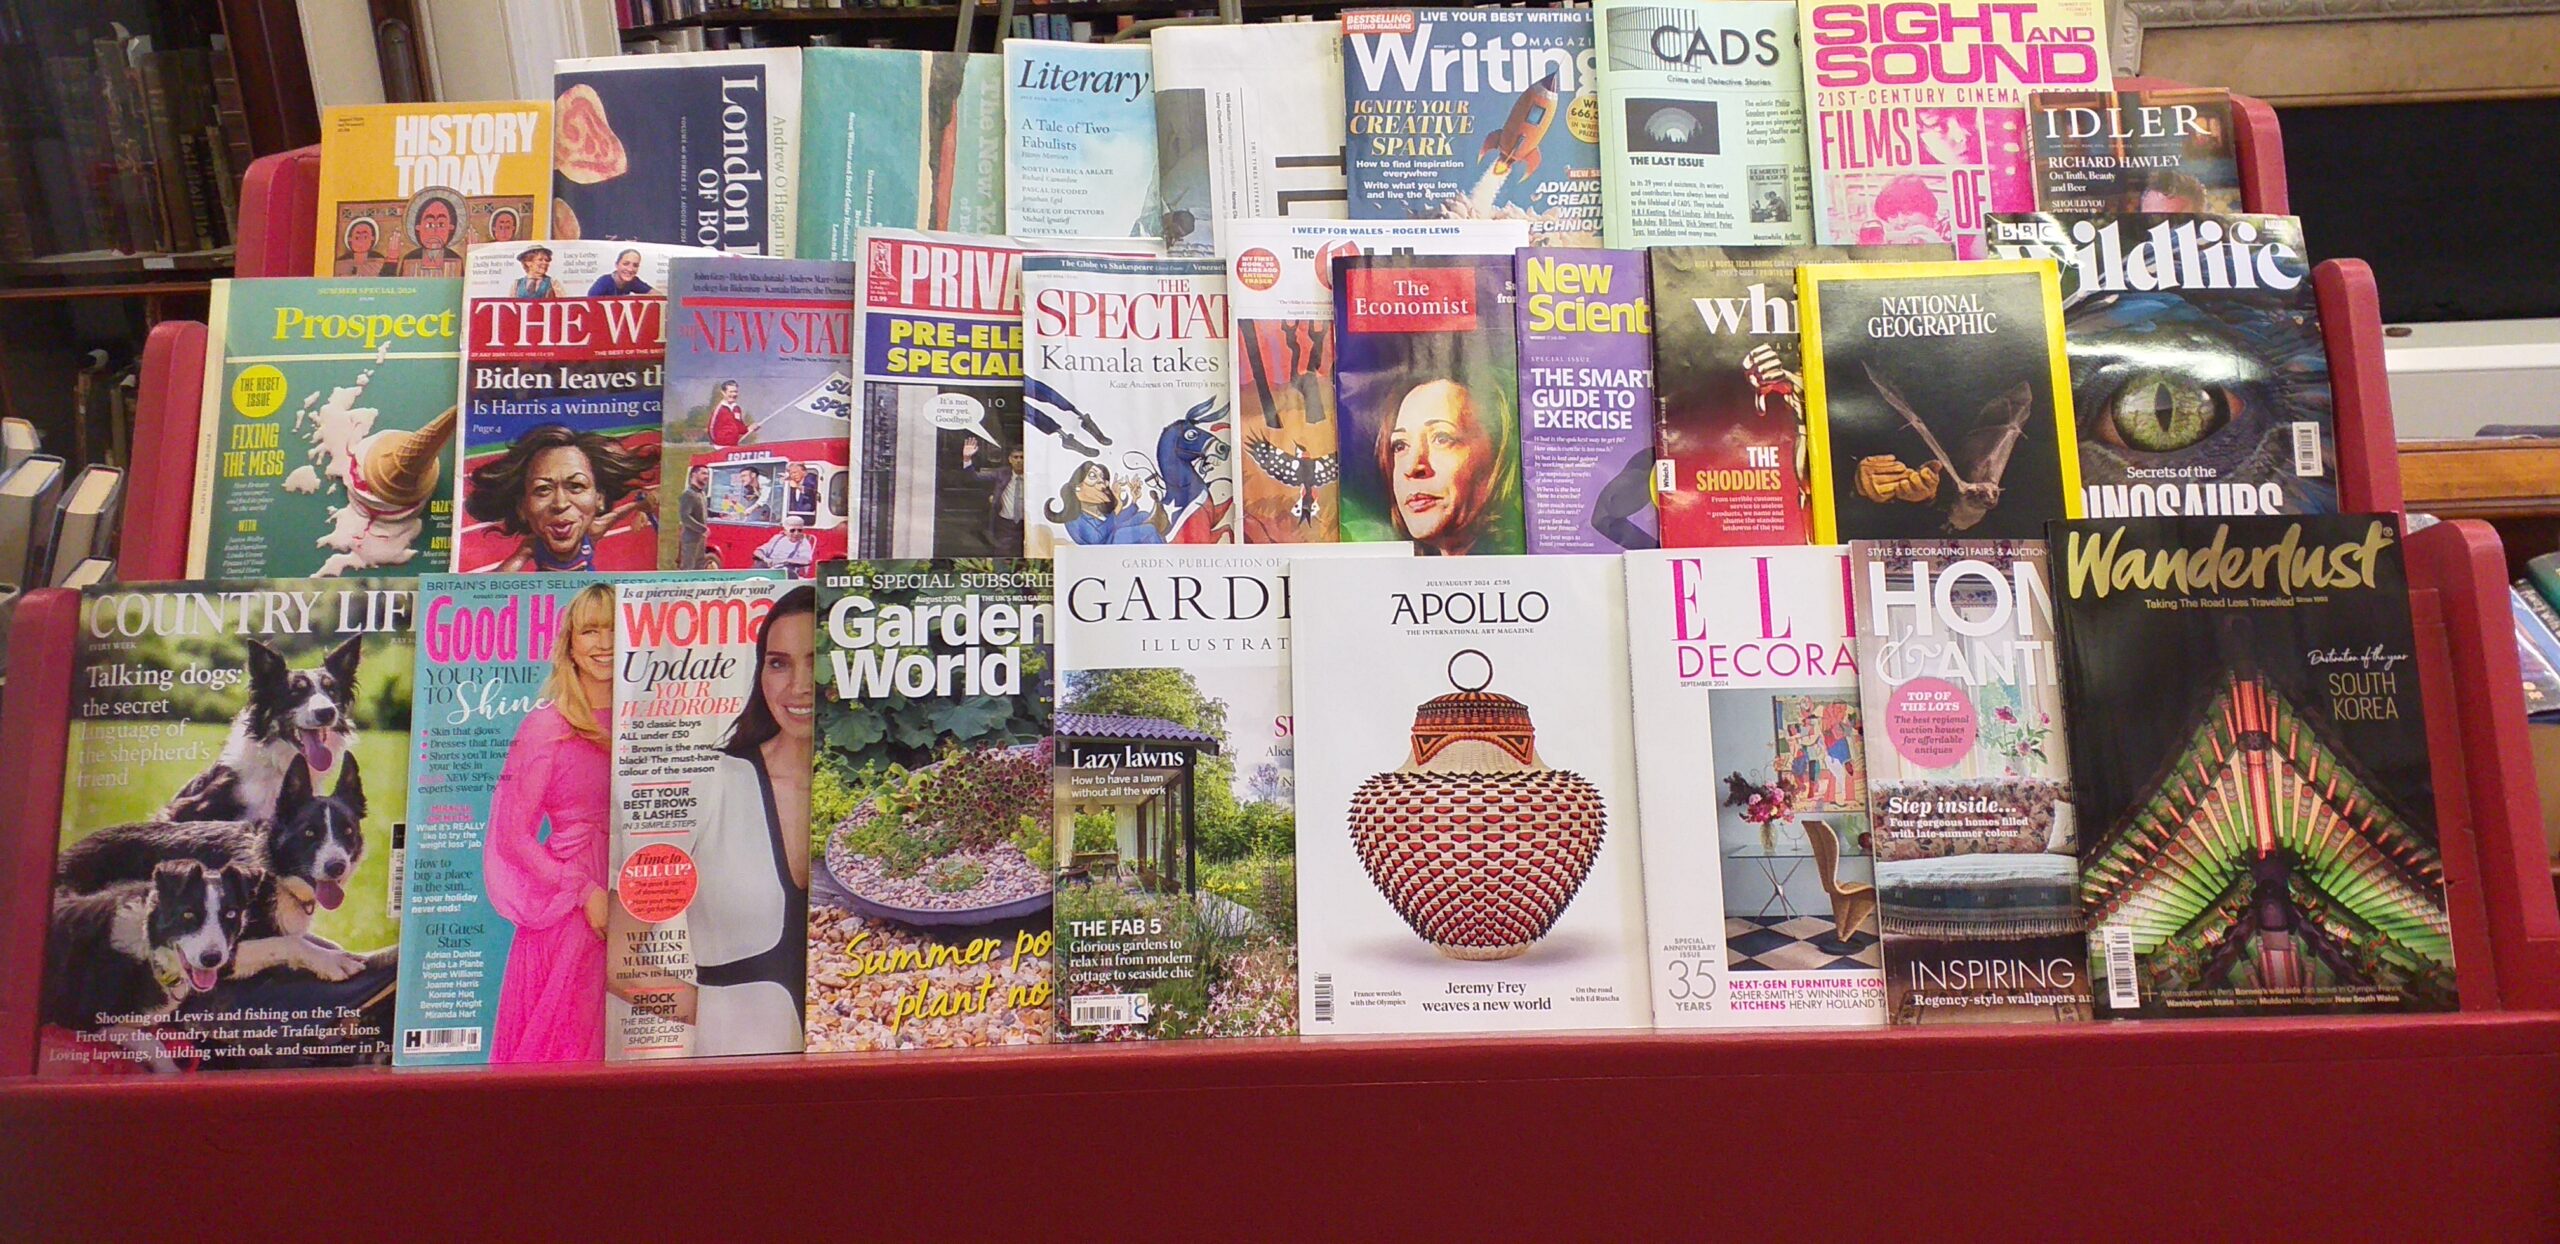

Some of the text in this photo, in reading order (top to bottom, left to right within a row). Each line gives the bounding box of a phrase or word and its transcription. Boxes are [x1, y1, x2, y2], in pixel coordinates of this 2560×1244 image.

[1420, 12, 1581, 23] LIVE YOUR BEST WRITING
[1812, 2, 2095, 46] SIGHT AND
[1650, 25, 1780, 67] CADS
[1814, 42, 2100, 88] SOUND
[1017, 59, 1152, 104] Literary
[1354, 100, 1469, 114] IGNITE YOUR
[1818, 88, 2020, 107] 21ST-CENTURY CINEMA
[1022, 118, 1110, 134] A Tale of Two
[1350, 115, 1475, 134] CREATIVE
[2044, 105, 2211, 138] IDLER
[395, 112, 538, 156] HISTORY
[1022, 136, 1077, 150] Fabulists
[1819, 107, 1913, 170] FILMS
[722, 76, 762, 234] London
[1371, 137, 1455, 156] SPARK
[1630, 157, 1704, 167] THE LAST ISSUE
[2048, 154, 2182, 168] RICHARD HAWLEY
[396, 155, 501, 198] TODAY
[2066, 172, 2088, 180] Truth,
[2089, 172, 2115, 182] Beauty
[2051, 184, 2086, 192] and Beer
[1952, 170, 1986, 229] OF
[1527, 256, 1613, 294] New
[1158, 279, 1189, 293] THE
[1393, 280, 1429, 296] The
[1356, 298, 1468, 316] Economist
[1529, 295, 1652, 334] Scient
[1881, 295, 1984, 315] NATIONAL
[272, 306, 457, 348] Prospect
[475, 301, 592, 347] THE
[693, 311, 775, 354] NEW
[1868, 312, 1997, 337] GEOGRAPHIC
[887, 347, 1023, 377] SPECIAL
[1041, 345, 1219, 373] Kamala takes
[475, 367, 637, 390] Biden leaves
[1531, 368, 1654, 388] THE SMART
[473, 398, 639, 417] Is Harris a winning
[1532, 389, 1636, 409] GUIDE TO
[935, 415, 972, 424] Goodbye!
[1533, 410, 1633, 430] EXERCISE
[231, 423, 280, 450] FIXING
[223, 450, 285, 477] THE MESS
[1746, 446, 1780, 468] THE
[1696, 470, 1782, 491] SHODDIES
[2127, 466, 2216, 479] Secrets of the
[2068, 520, 2394, 599] Wanderlust
[826, 574, 955, 590] BBC SPECIAL
[1391, 591, 1549, 625] APOLLO
[2145, 597, 2294, 611] Taking The Road Less Travelled
[89, 591, 323, 639] COUNTRY
[828, 594, 1054, 649] Garden
[425, 594, 519, 665] Good
[86, 664, 242, 690] Talking dogs:
[426, 666, 540, 685] YOUR TIME
[623, 649, 737, 692] Update
[830, 646, 1021, 700] World
[2328, 672, 2397, 696] SOUTH
[423, 686, 452, 705] TO
[446, 677, 555, 725] Shine
[1907, 692, 1951, 700] TOP OF
[82, 699, 168, 718] the secret
[1900, 703, 1960, 712] THE LOTS
[2333, 697, 2399, 720] KOREA
[1071, 745, 1185, 775] Lazy lawns
[1889, 796, 2017, 817] Step inside...
[1070, 918, 1162, 937] THE FAB 5
[840, 932, 1002, 977] Summer
[1667, 959, 1717, 1000] 35
[1728, 979, 1788, 990] NEXT-GEN
[1790, 979, 1853, 988] FURNITURE
[1910, 958, 2076, 991] INSPIRING
[633, 993, 675, 1004] SHOCK
[1445, 981, 1527, 997] Jeremy Frey
[631, 1005, 677, 1016] REPORT
[892, 972, 996, 1036] plant
[1422, 997, 1552, 1012] weaves a new world
[1675, 1002, 1712, 1012] YEARS
[95, 1006, 361, 1026] Shooting on Lewis and fishing on the Test
